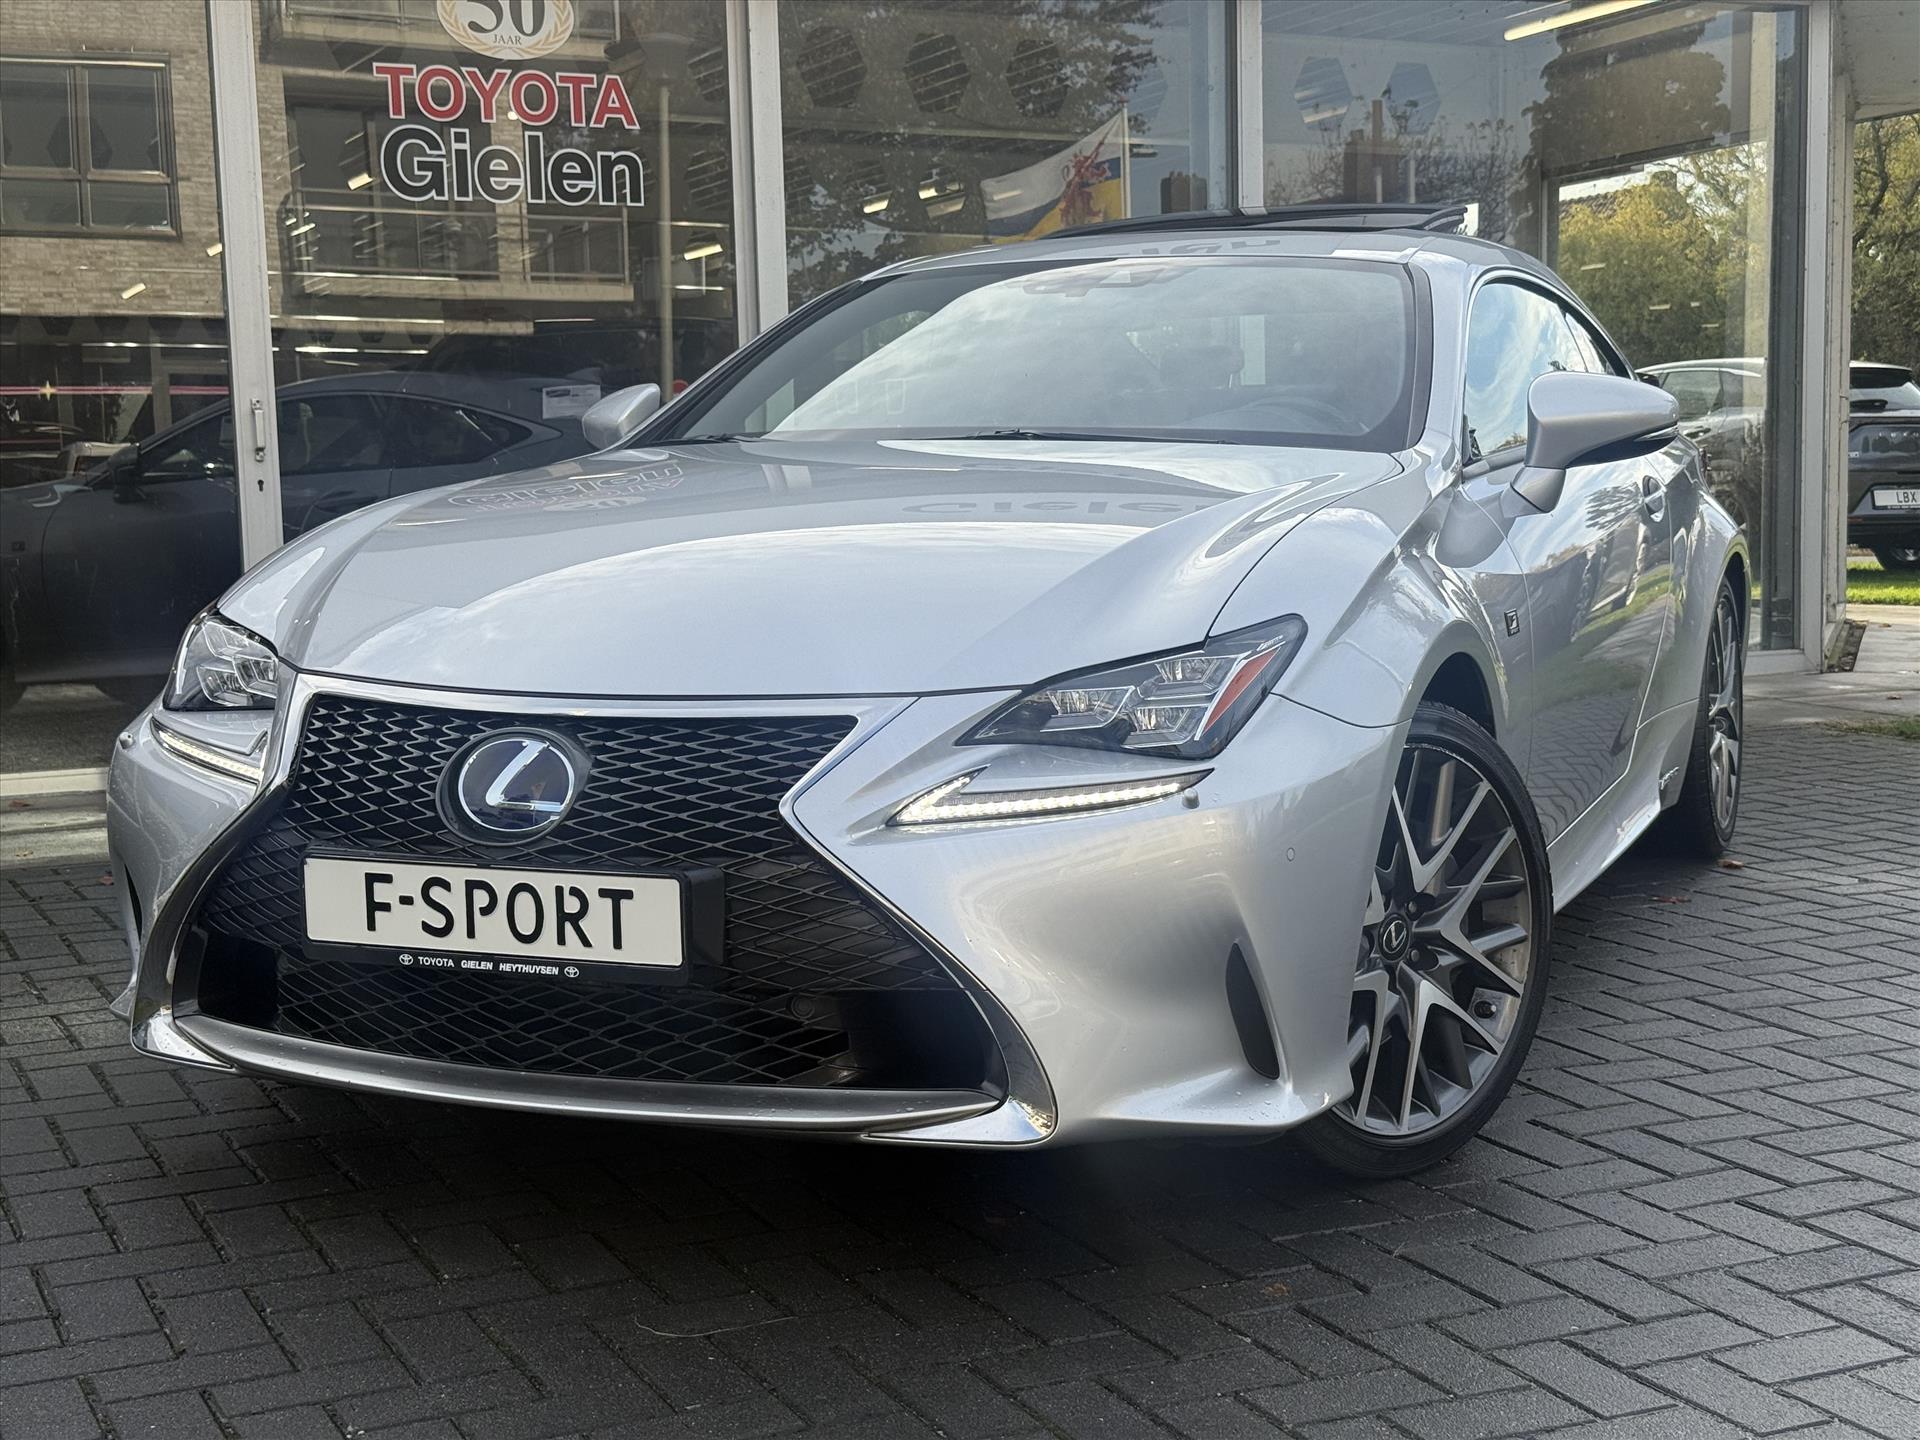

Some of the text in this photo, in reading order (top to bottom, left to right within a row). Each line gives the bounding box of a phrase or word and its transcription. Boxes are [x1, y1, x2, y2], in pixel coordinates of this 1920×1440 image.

[493, 34, 522, 45] JAAR
[372, 62, 640, 130] TOYOTA
[381, 124, 644, 206] Gielen
[1896, 491, 1917, 503] LBX
[364, 872, 634, 950] F-SPORT
[418, 956, 559, 975] TOYOTA GIELEN HEYTHUYSEN
